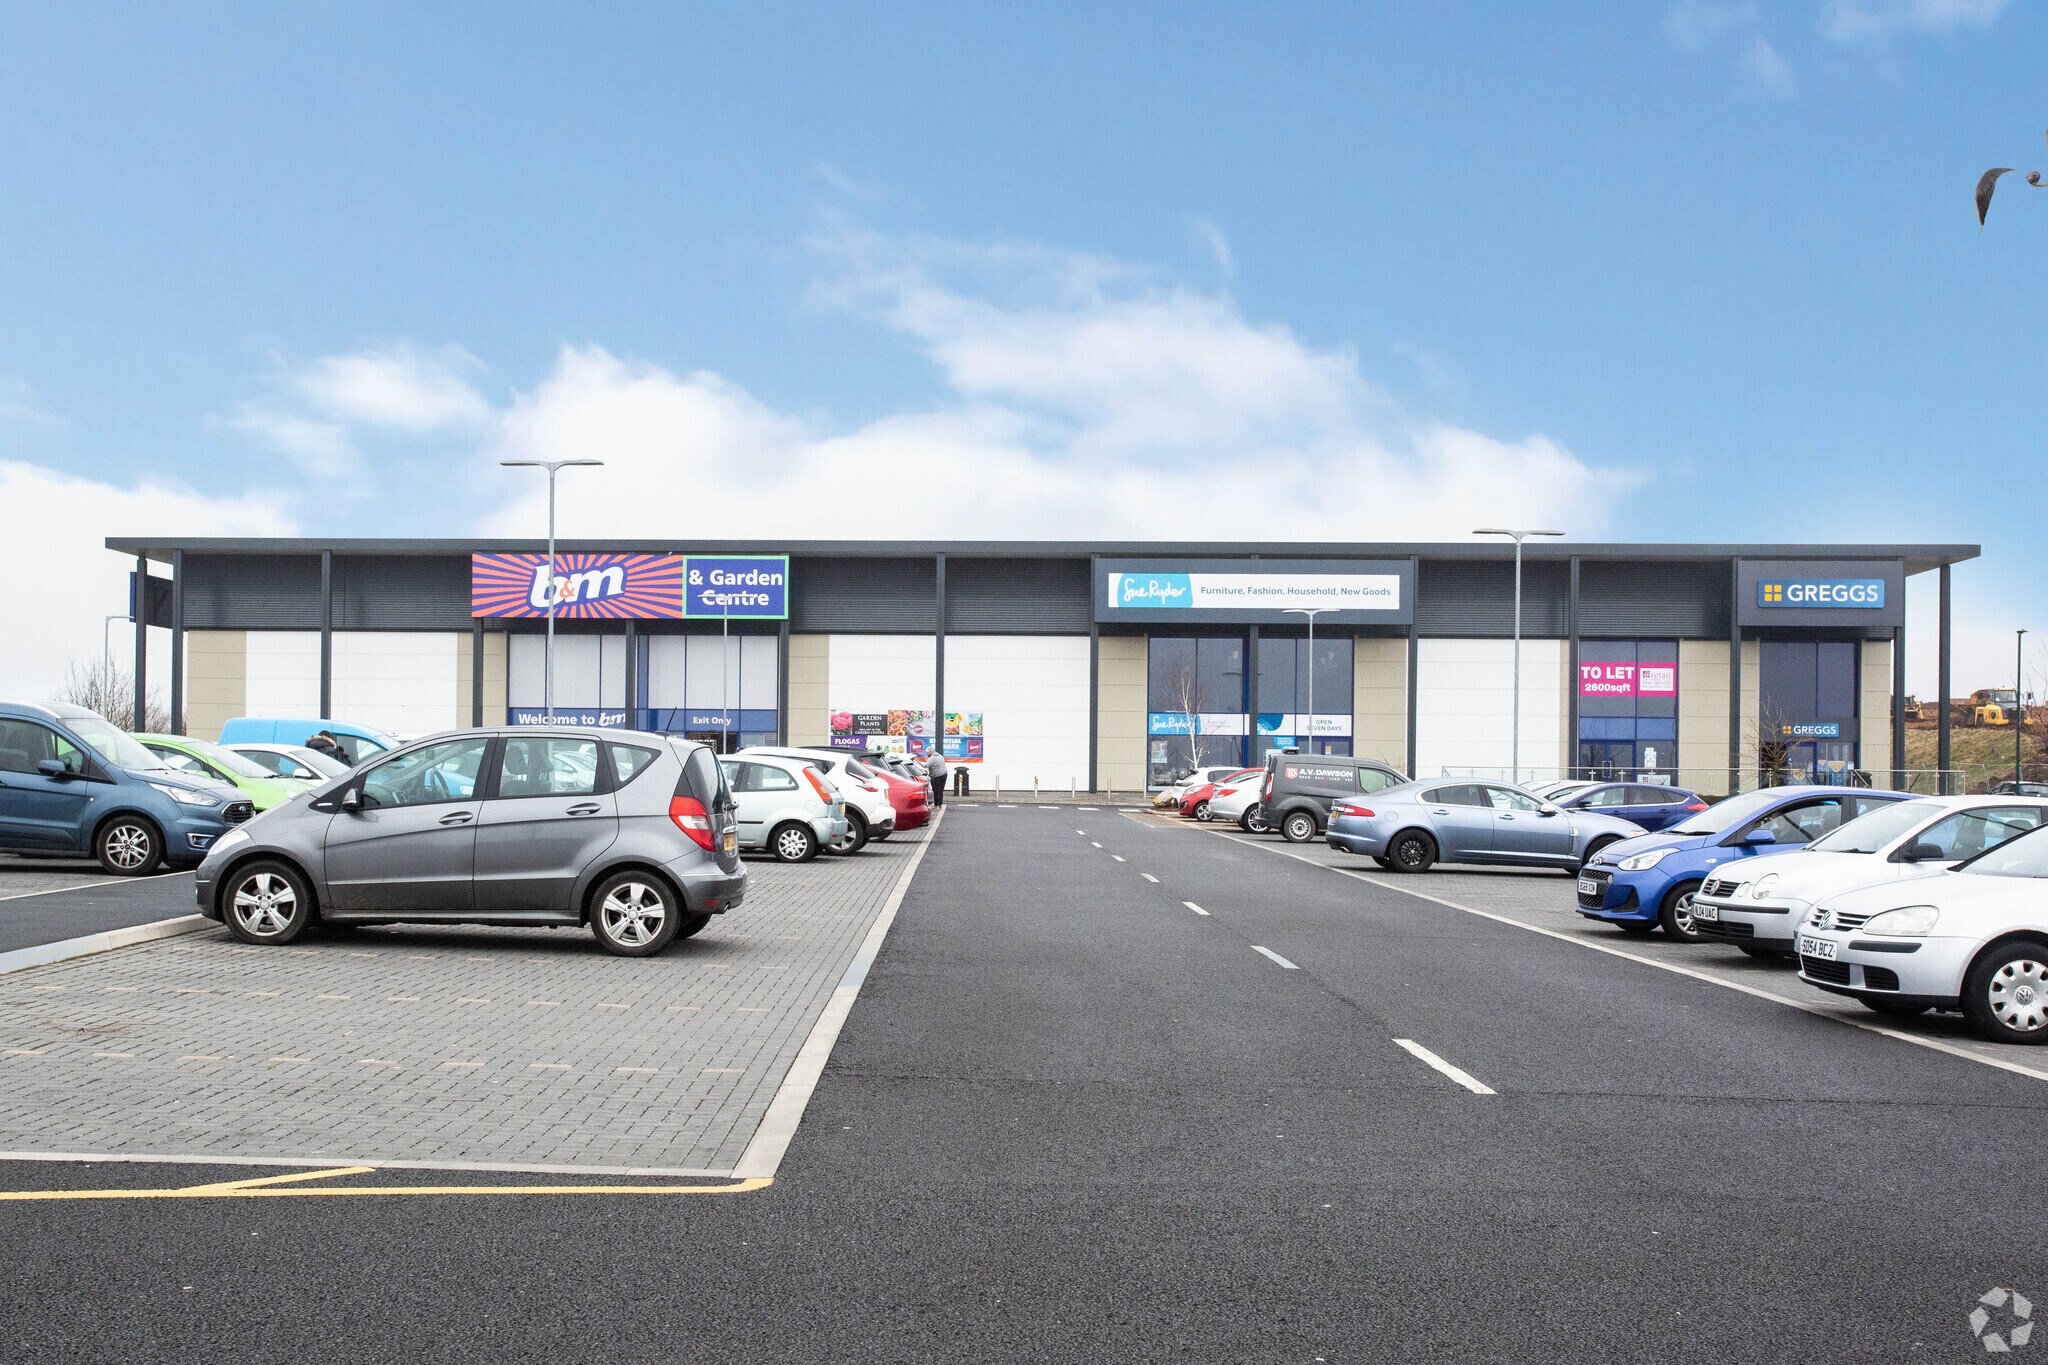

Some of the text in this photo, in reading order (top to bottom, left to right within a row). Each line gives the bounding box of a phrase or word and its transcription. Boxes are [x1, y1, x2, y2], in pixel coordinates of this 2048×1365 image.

[688, 569, 783, 586] & Garden
[1123, 577, 1187, 605] Sue Ryder
[1200, 586, 1391, 598] Furniture, Fashion, Household, New Goods
[1787, 584, 1879, 602] GREGGS
[701, 590, 769, 606] Centre
[1581, 666, 1635, 679] TO LET
[1585, 683, 1631, 693] 2600sqft
[581, 714, 595, 725] to
[693, 716, 731, 726] Exit Ony
[1152, 715, 1168, 731] Sue
[1793, 725, 1837, 735] GREGGS
